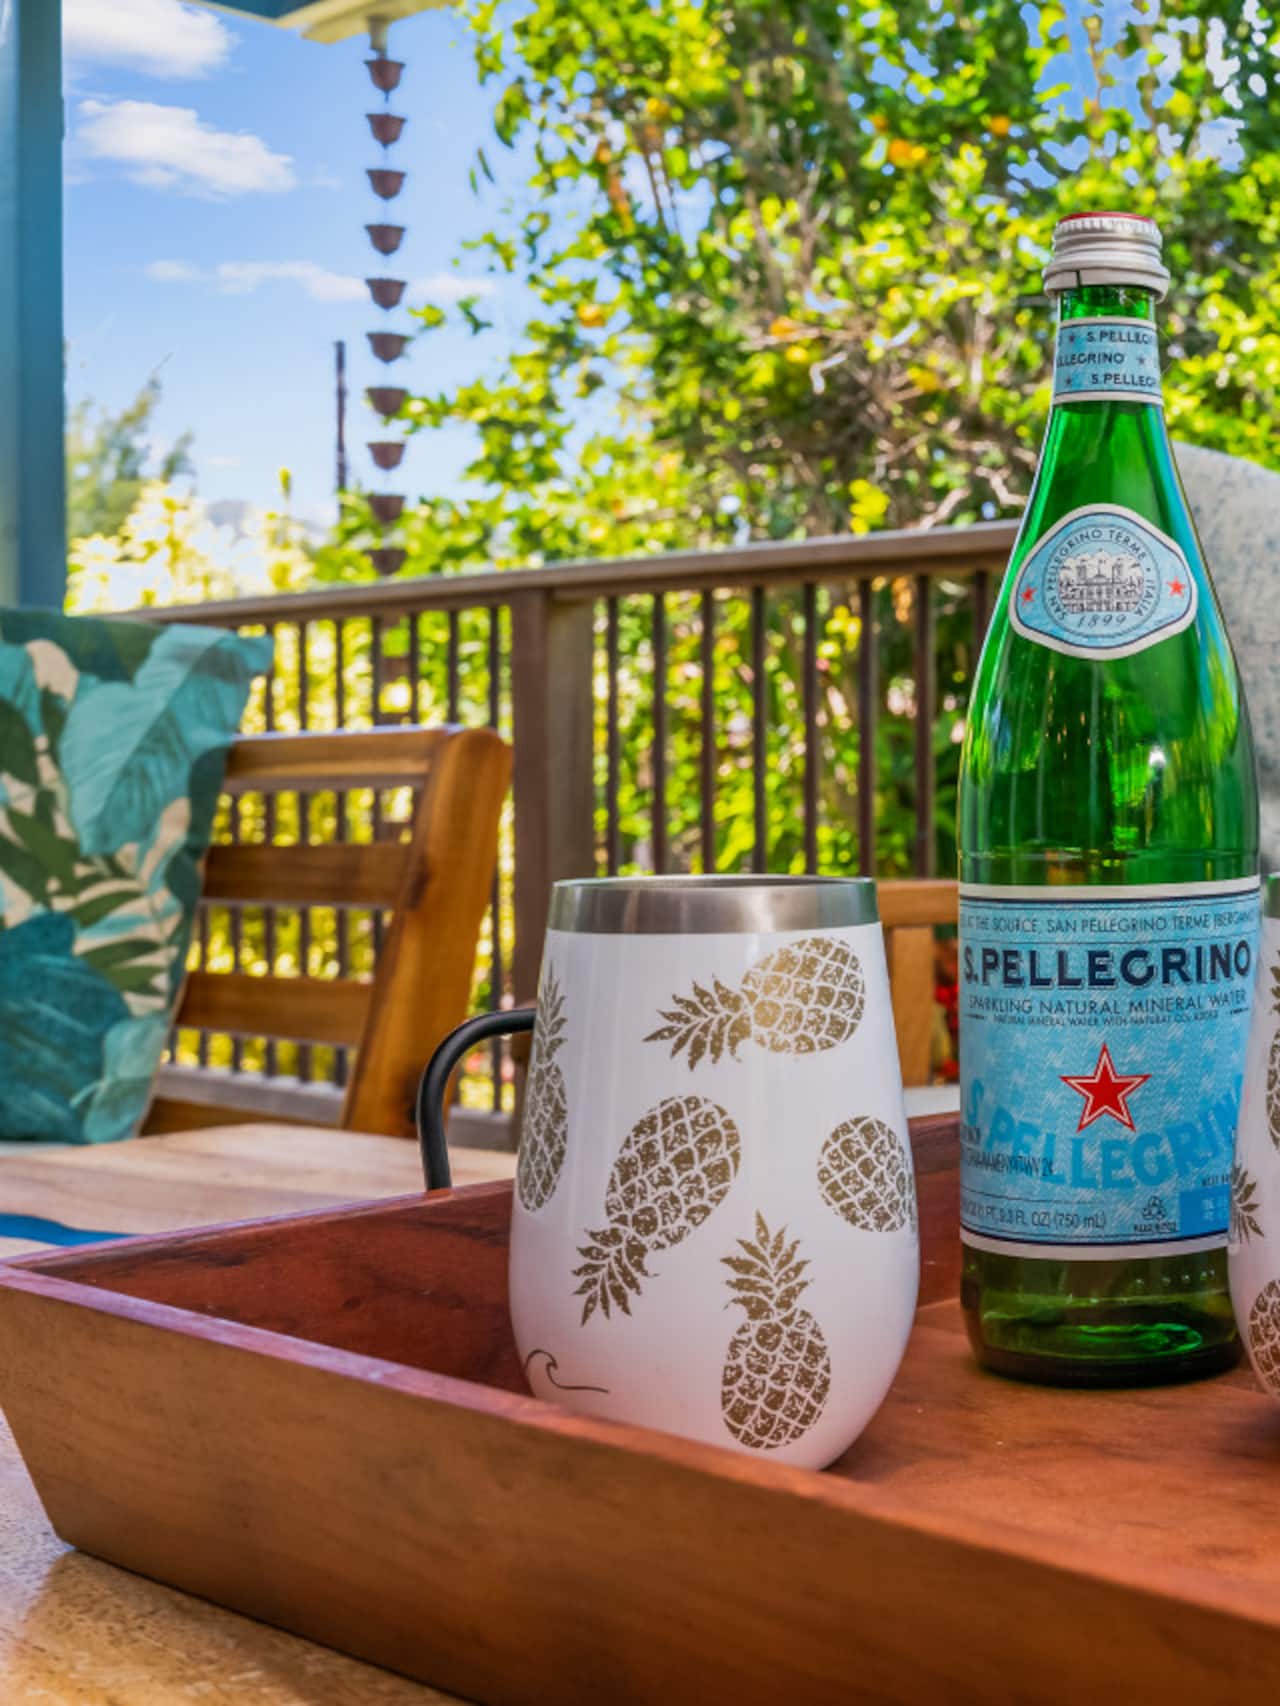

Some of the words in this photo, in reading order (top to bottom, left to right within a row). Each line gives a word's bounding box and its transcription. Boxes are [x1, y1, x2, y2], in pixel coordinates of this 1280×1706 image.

[1046, 528, 1103, 592] PELLEGRINO
[1109, 529, 1147, 562] TERME
[1132, 579, 1157, 618] ITALIA
[1076, 613, 1127, 630] 1899
[1047, 919, 1077, 933] SAN
[1081, 916, 1167, 934] PELLEGRINO
[1172, 913, 1209, 931] TERME
[964, 939, 1251, 989] S.PELLEGRINO
[967, 995, 1033, 1014] SPARKLING
[1040, 999, 1120, 1015] NATURAL
[1129, 996, 1202, 1013] MINERAL
[1209, 989, 1247, 1008] WATER
[1067, 1015, 1099, 1026] WATER
[1054, 1211, 1080, 1229] (750
